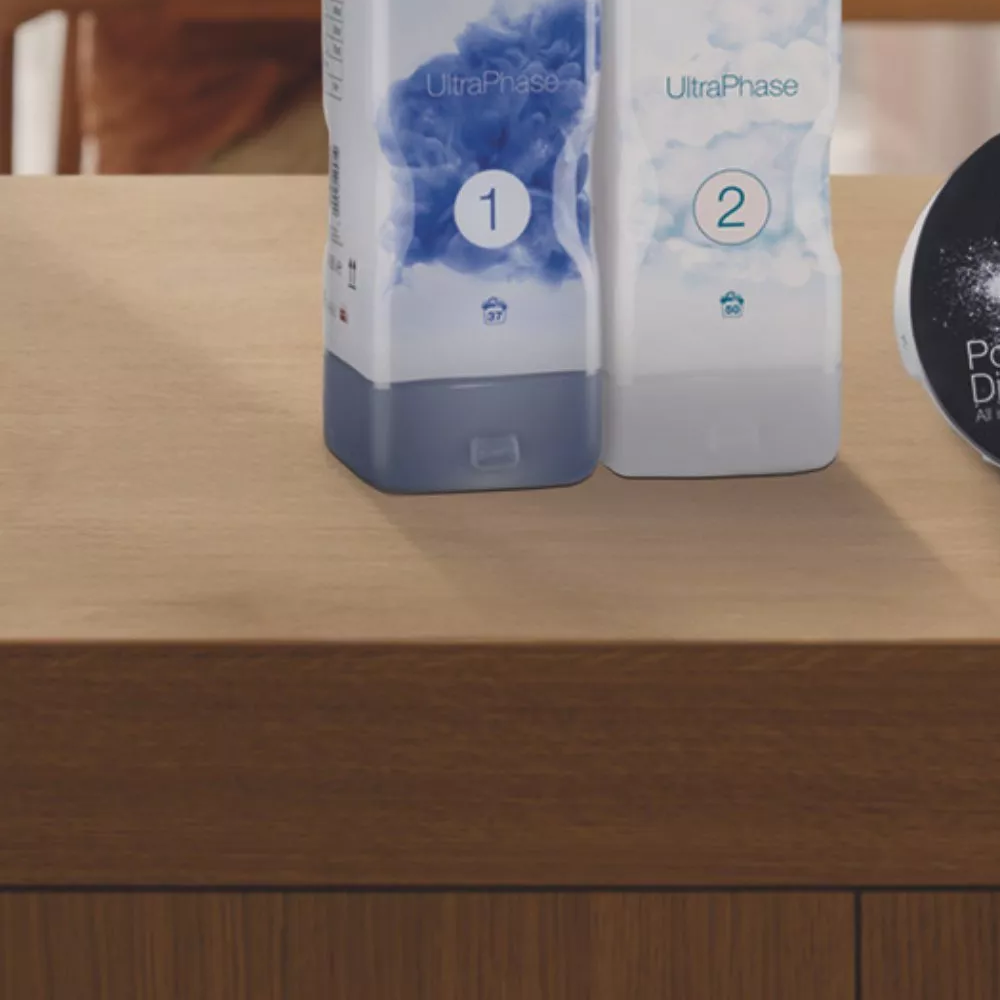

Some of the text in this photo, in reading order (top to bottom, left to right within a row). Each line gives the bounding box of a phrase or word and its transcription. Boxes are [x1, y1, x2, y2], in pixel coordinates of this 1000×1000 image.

[426, 70, 560, 98] UltraPhase
[665, 73, 799, 100] UltraPhase
[479, 187, 496, 231] 1
[717, 185, 746, 228] 2
